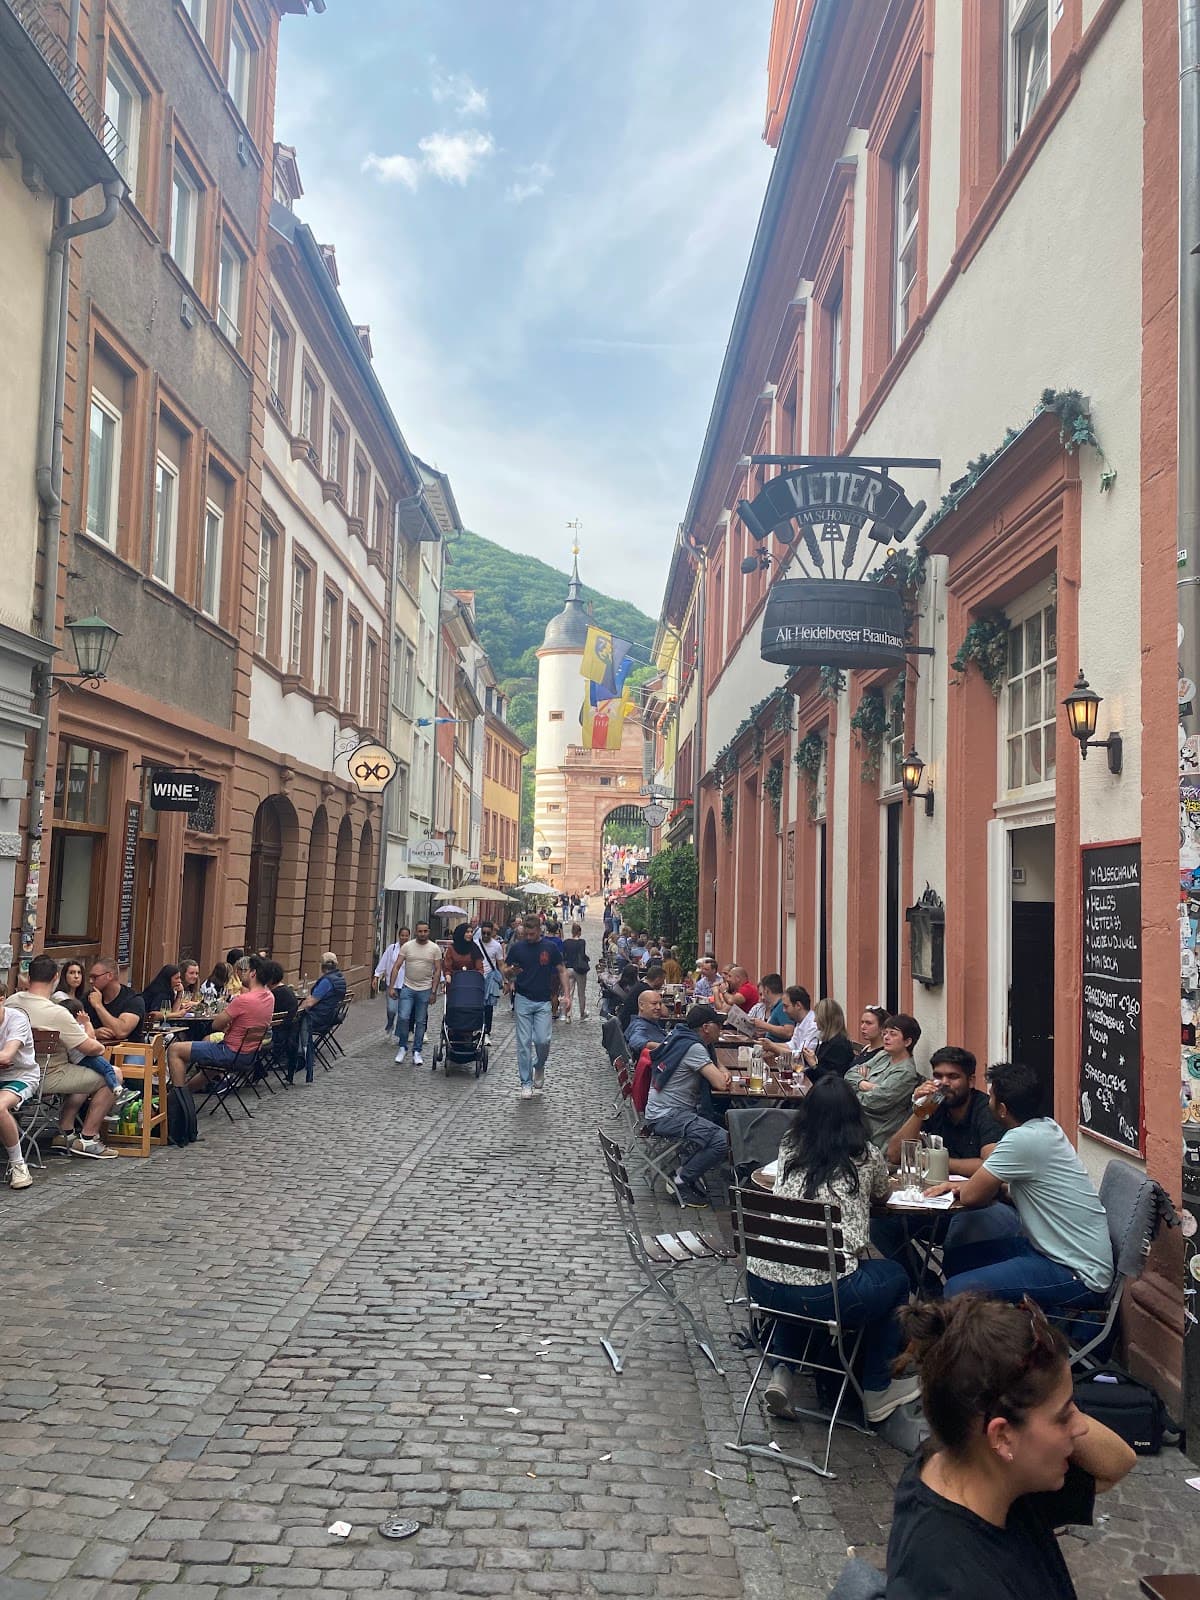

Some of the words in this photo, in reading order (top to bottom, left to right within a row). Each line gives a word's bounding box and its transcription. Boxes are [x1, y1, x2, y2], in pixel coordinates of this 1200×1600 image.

[786, 471, 883, 513] VETTER
[798, 513, 814, 525] IM
[776, 626, 861, 643] Alt-Heidelberger
[863, 628, 904, 649] Brauhaus
[1090, 893, 1117, 912] HELLES
